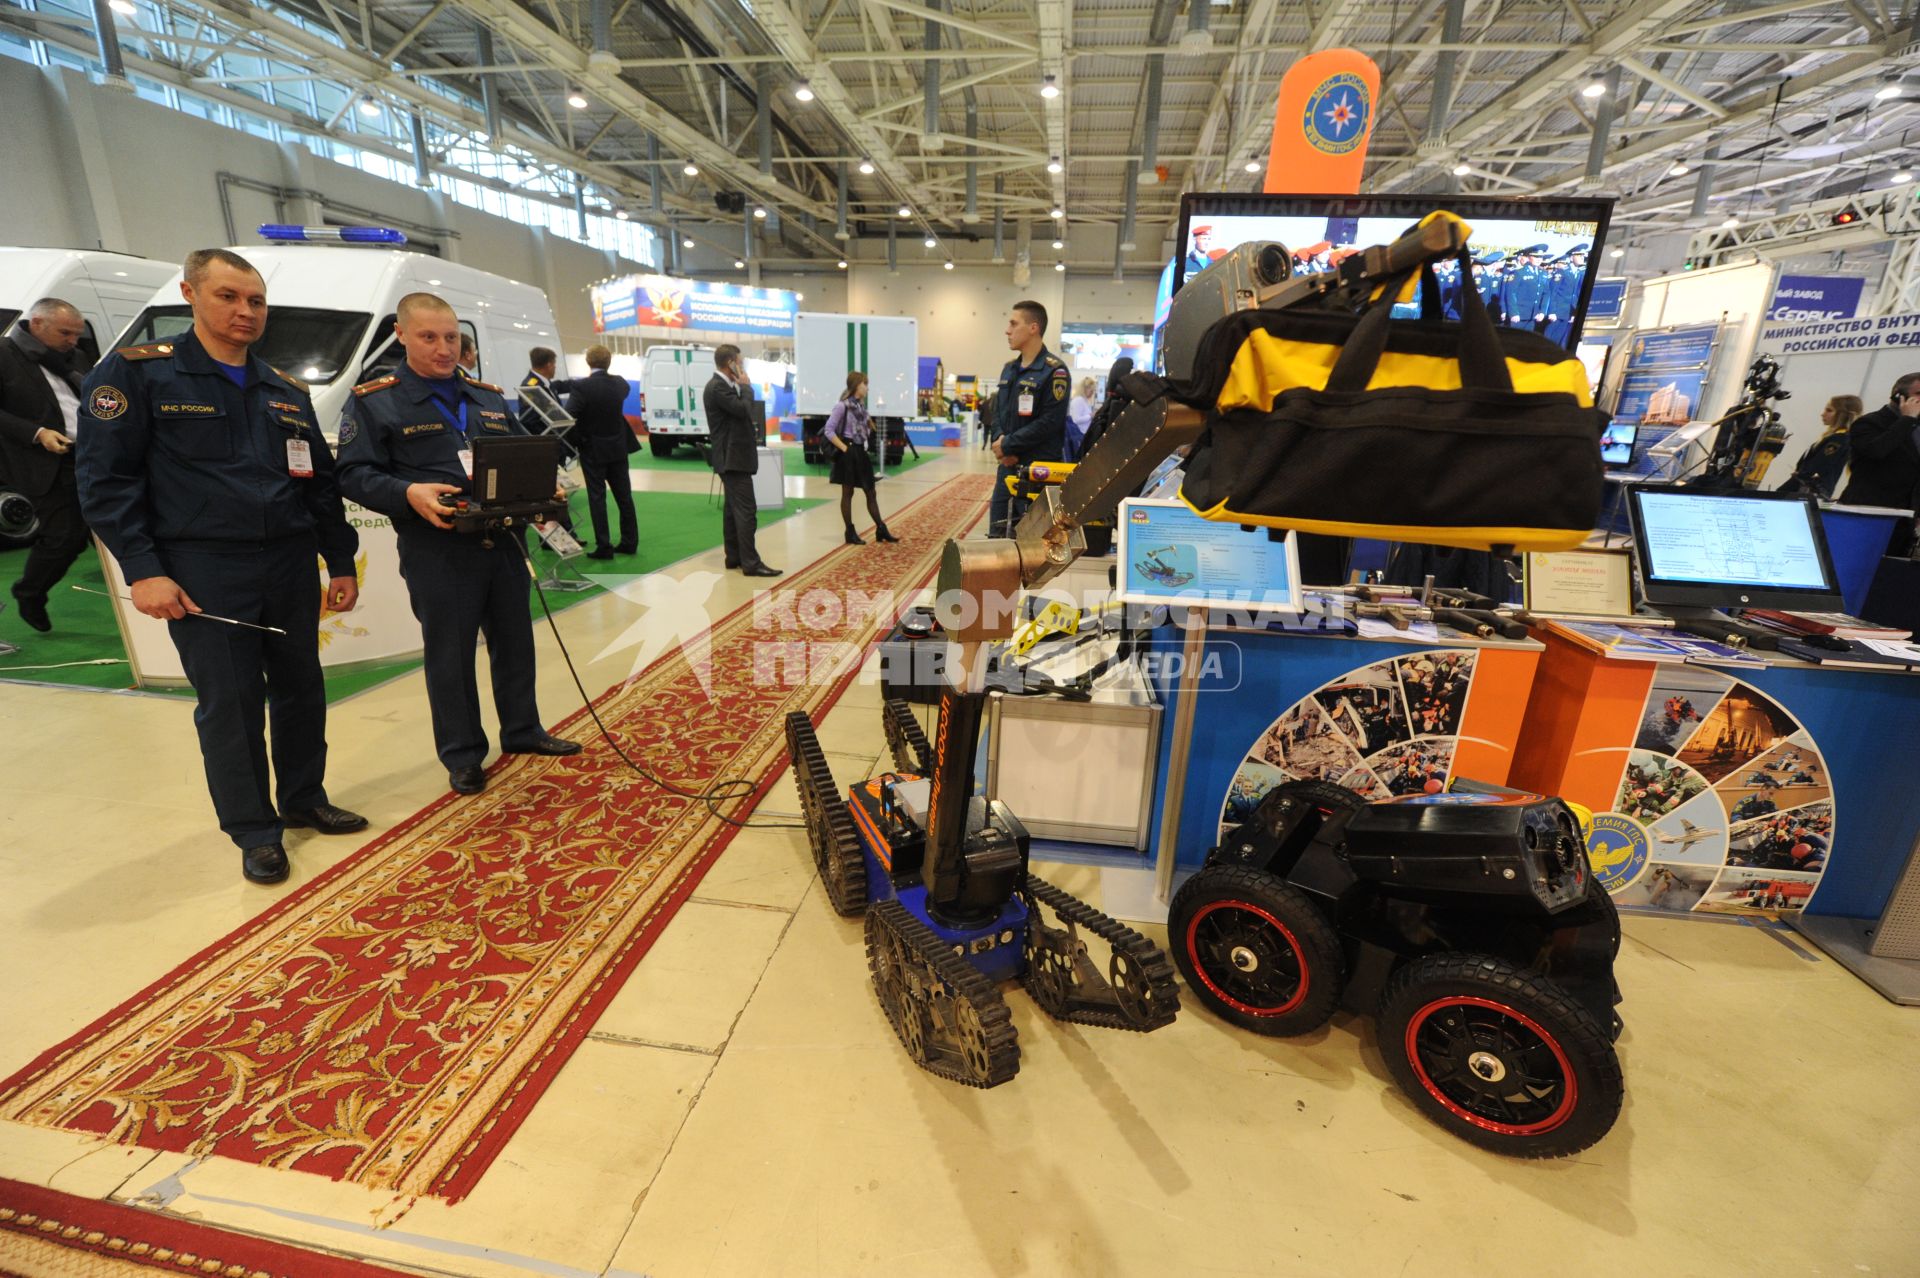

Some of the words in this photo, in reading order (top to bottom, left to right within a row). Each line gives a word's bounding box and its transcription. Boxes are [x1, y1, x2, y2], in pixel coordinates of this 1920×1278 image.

[1764, 319, 1872, 340] МИНИСТЕРСТВО
[1783, 332, 1881, 353] РОССИЙСКОЙ
[161, 404, 179, 413] МЧС
[181, 404, 215, 413] РОССИИ
[402, 425, 417, 436] МЧС
[417, 423, 444, 434] РОССИИ
[937, 694, 951, 767] ЦСООР
[1627, 827, 1644, 846] ГПС
